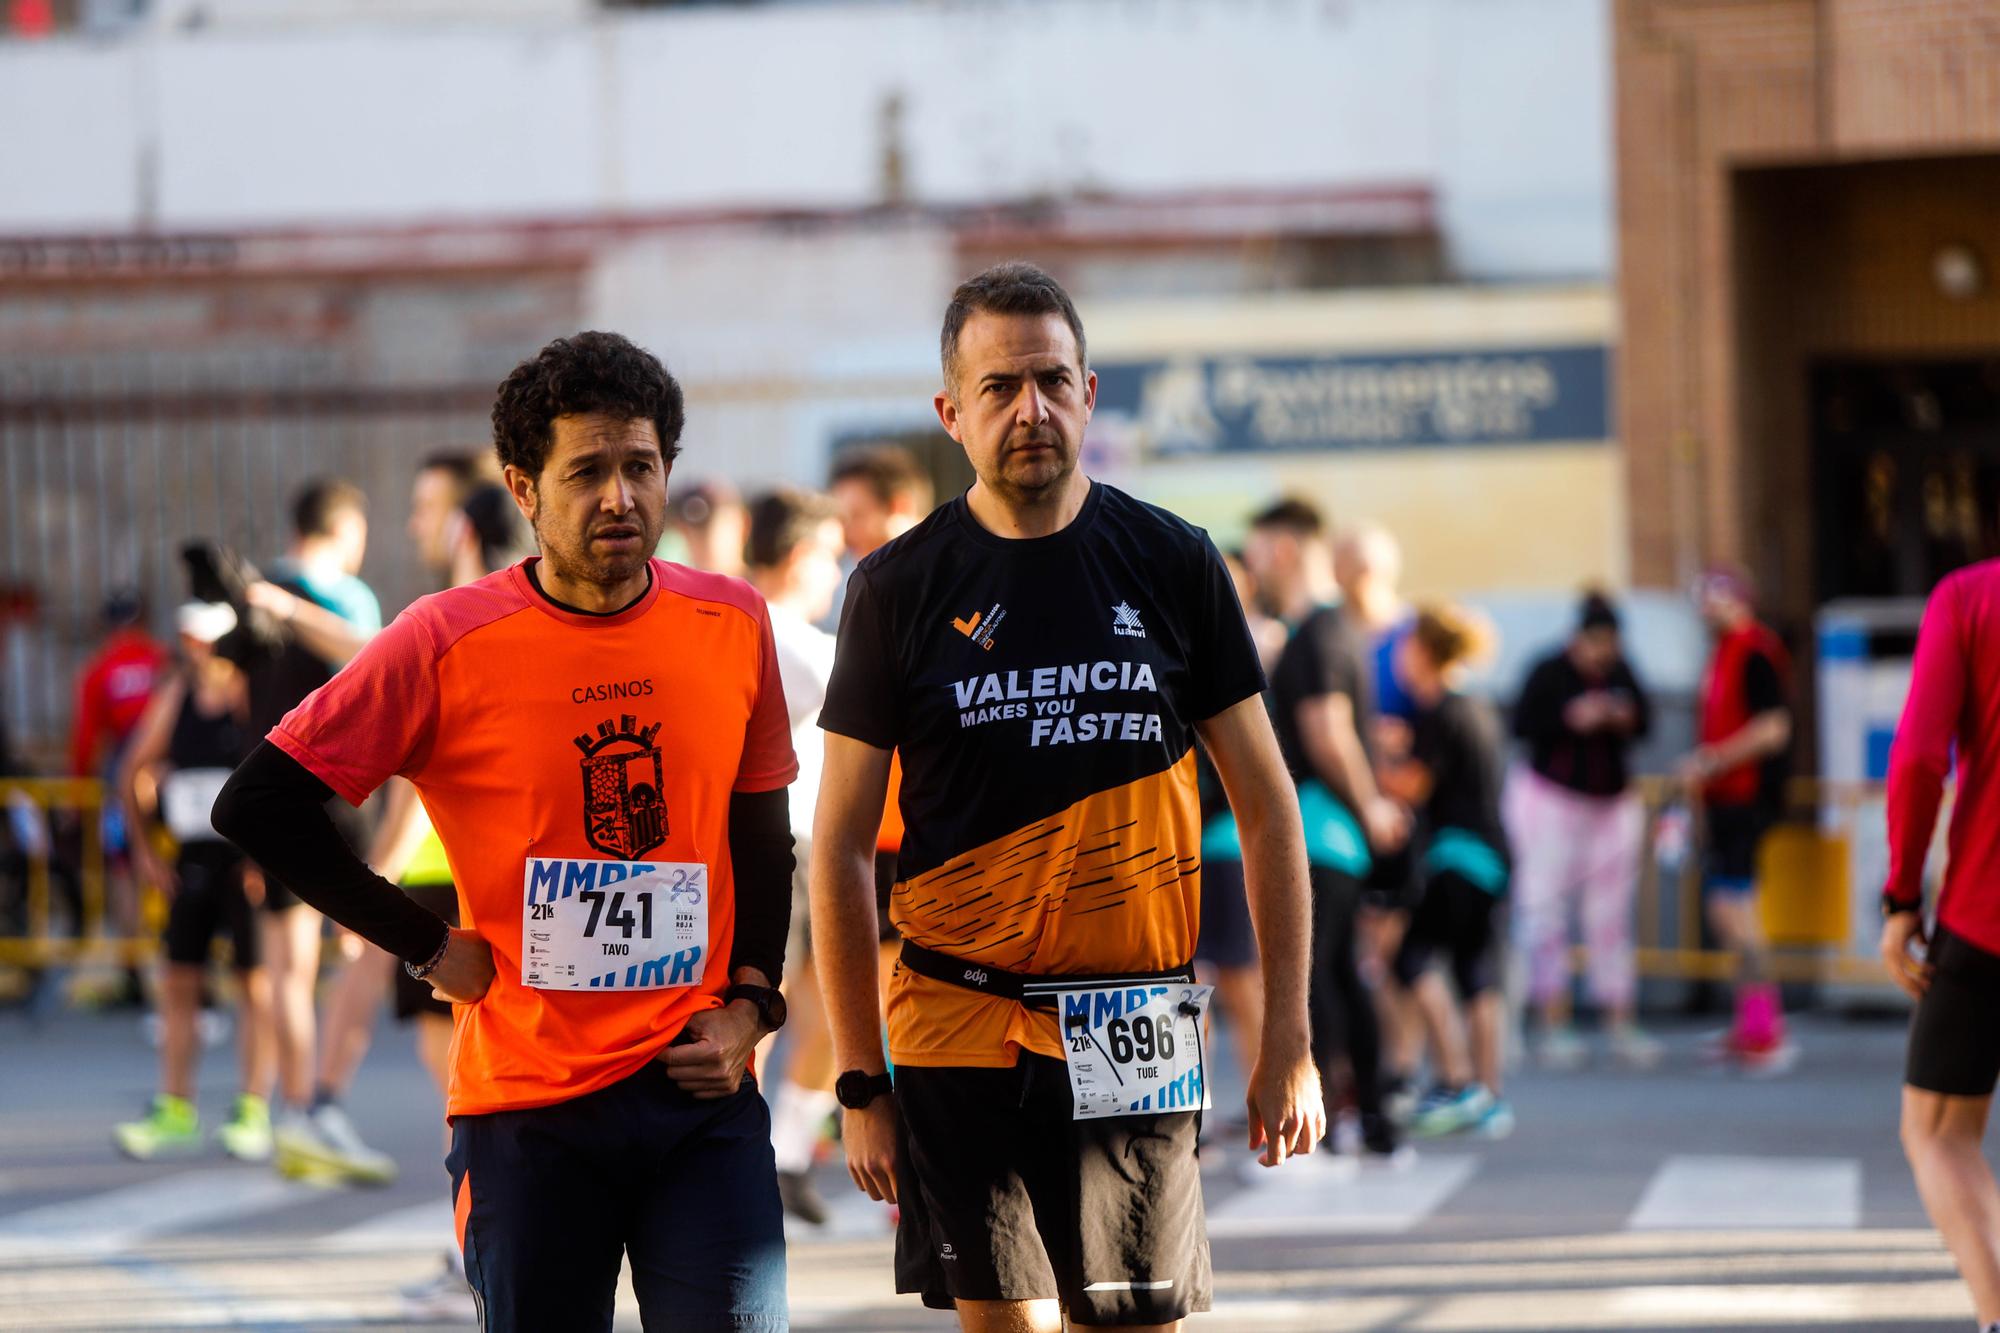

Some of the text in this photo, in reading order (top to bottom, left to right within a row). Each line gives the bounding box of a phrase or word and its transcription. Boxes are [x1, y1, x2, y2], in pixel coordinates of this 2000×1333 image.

[1113, 626, 1146, 638] luanvi
[571, 679, 654, 704] CASINOS
[953, 660, 1158, 710] VALENCIA
[960, 699, 1076, 728] MAKES YOU
[1031, 712, 1162, 747] FASTER
[579, 890, 653, 939] 741
[602, 943, 629, 956] TAVO
[963, 968, 988, 986] edp
[1107, 1013, 1175, 1064] 696
[1136, 1066, 1159, 1080] TUDE
